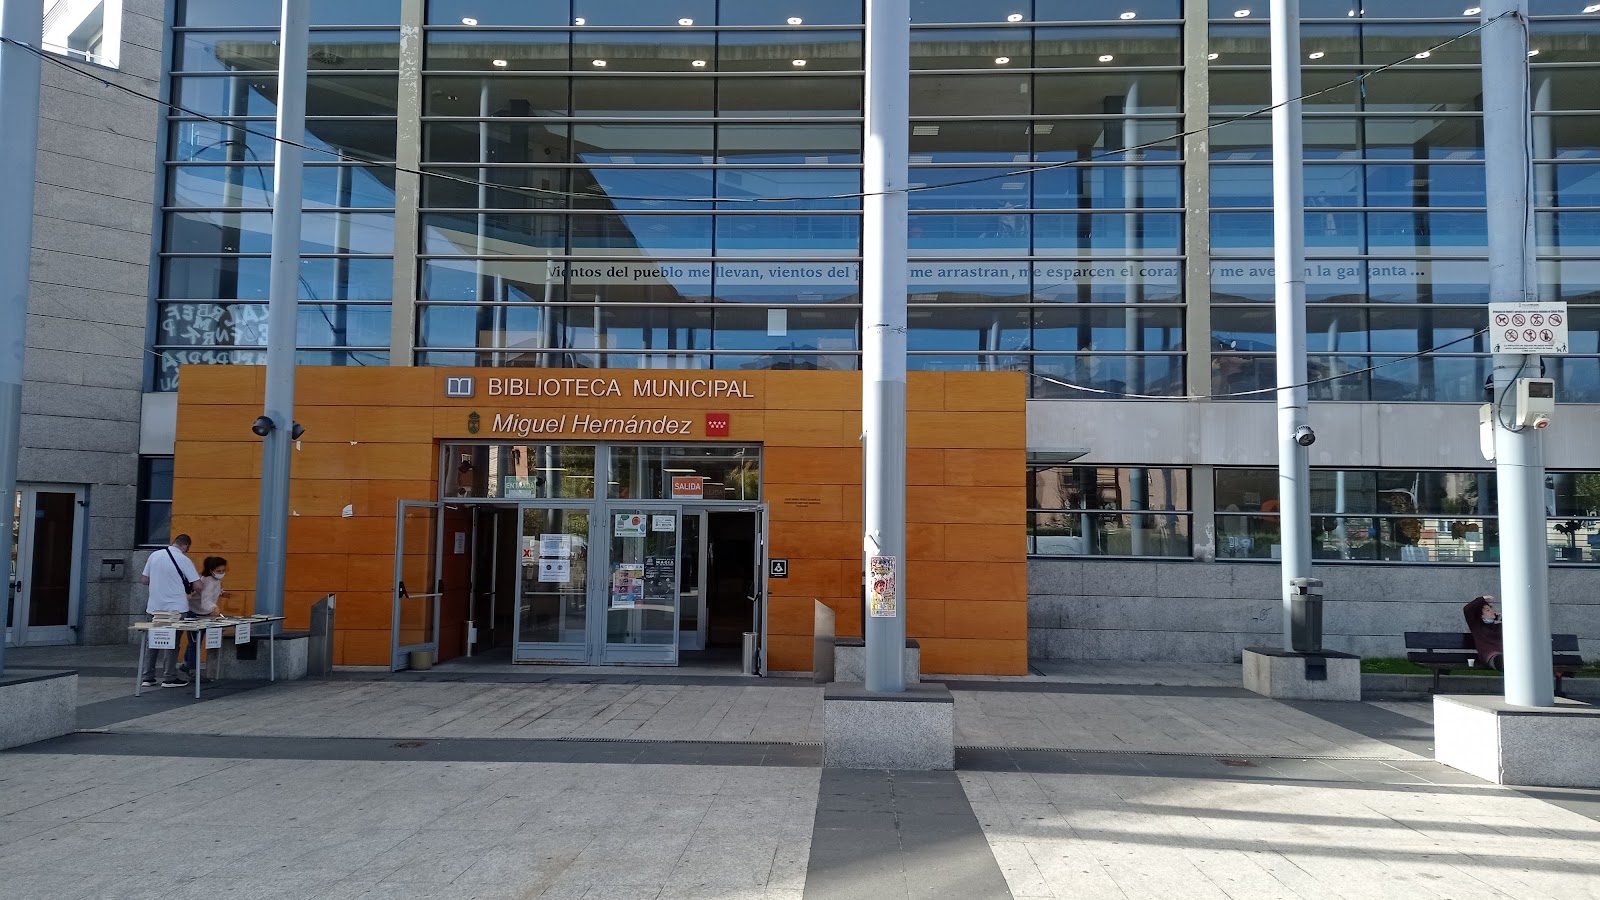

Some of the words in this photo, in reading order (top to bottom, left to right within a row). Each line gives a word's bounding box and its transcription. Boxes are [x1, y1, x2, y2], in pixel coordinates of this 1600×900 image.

[606, 266, 629, 278] del
[633, 266, 683, 281] pueblo
[688, 268, 710, 278] me
[714, 266, 764, 280] llevan,
[768, 266, 823, 278] vientos
[827, 266, 849, 278] del
[910, 267, 933, 278] me
[937, 266, 1015, 281] arrastran,
[1046, 267, 1115, 281] esparcen
[1120, 265, 1135, 278] el
[1220, 267, 1244, 278] me
[1317, 264, 1331, 277] la
[488, 378, 622, 397] BIBLIOTECA
[632, 379, 755, 399] MUNICIPAL
[491, 413, 567, 438] Miguel
[571, 414, 692, 435] Hernández
[674, 482, 701, 490] SALIDA
